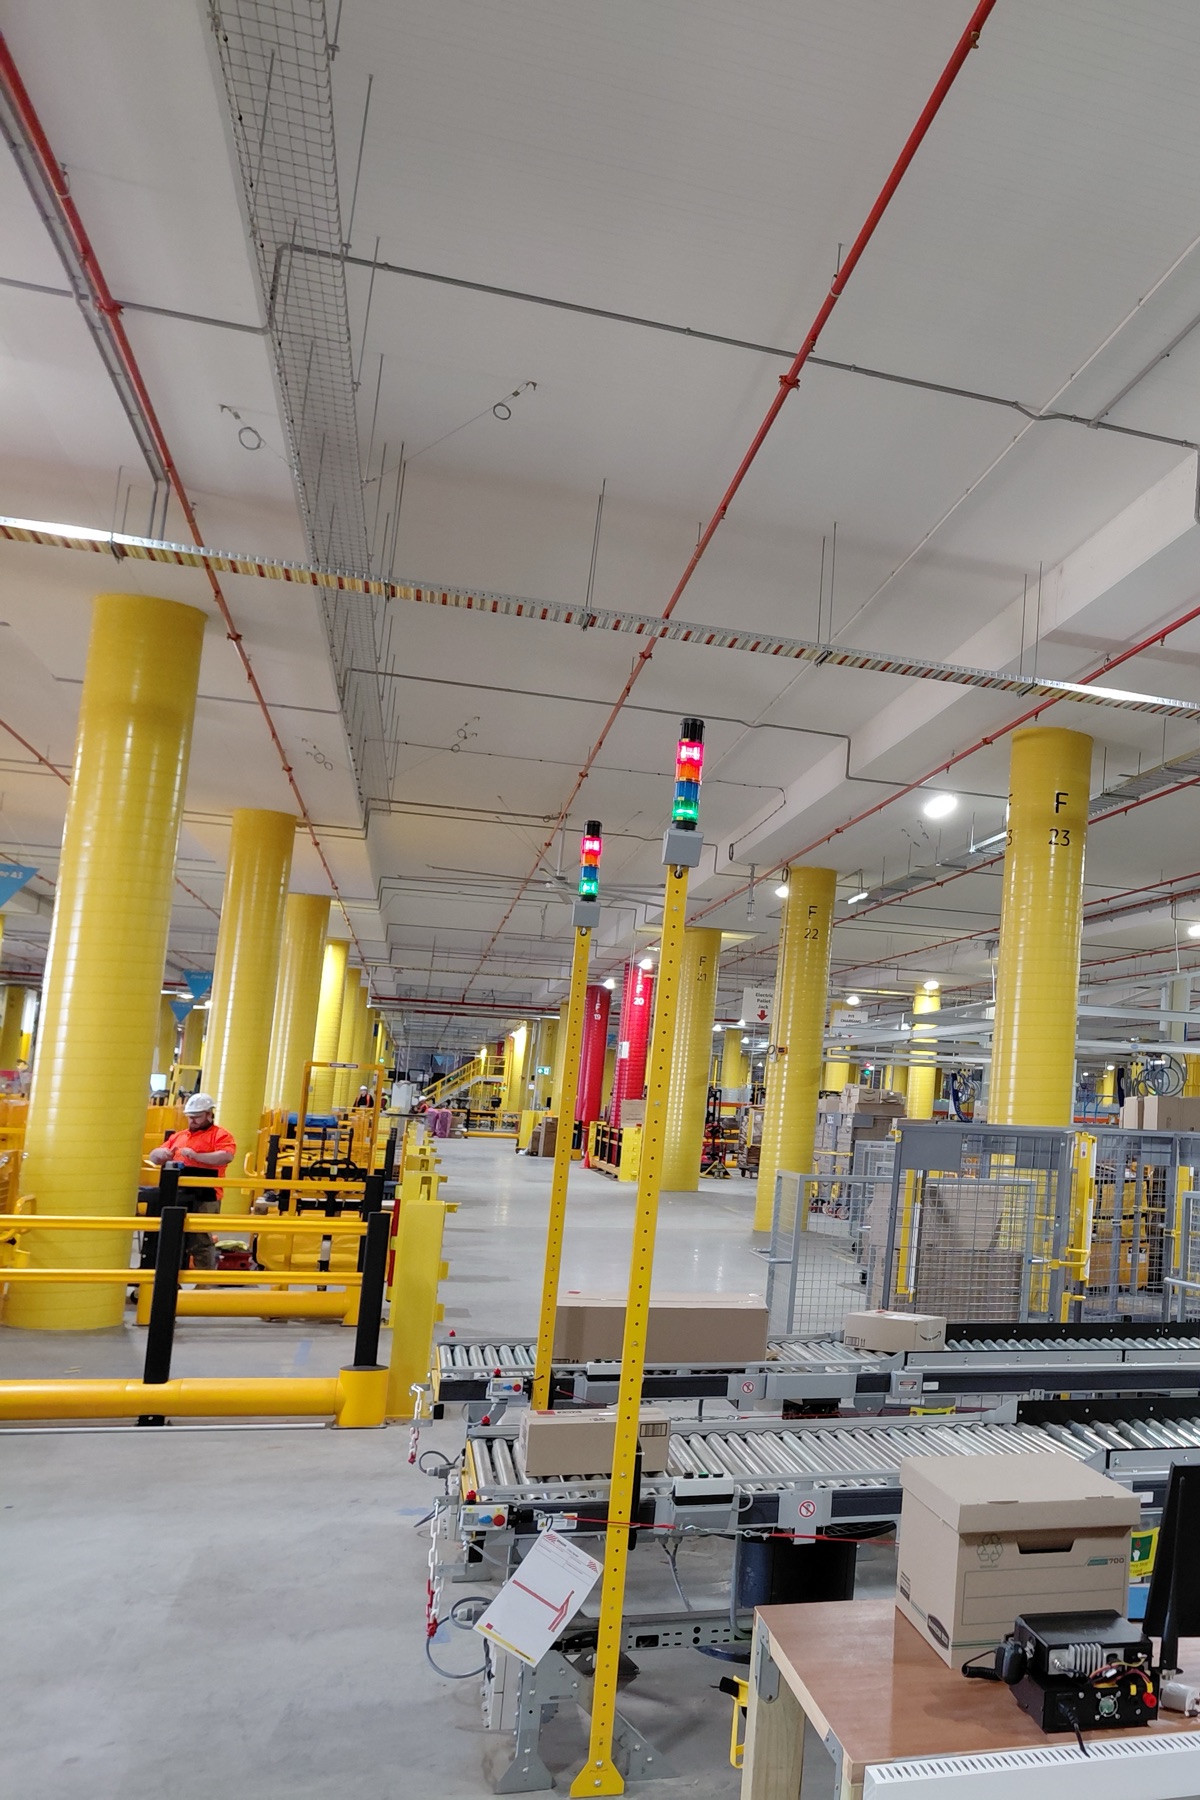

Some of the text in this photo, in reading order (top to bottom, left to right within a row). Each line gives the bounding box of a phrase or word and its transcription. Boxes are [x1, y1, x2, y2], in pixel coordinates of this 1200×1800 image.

[1055, 792, 1069, 813] F
[1048, 828, 1070, 846] 23
[808, 905, 818, 919] F
[804, 928, 819, 939] 22
[699, 956, 707, 966] F
[635, 984, 644, 994] F
[633, 997, 645, 1006] 20
